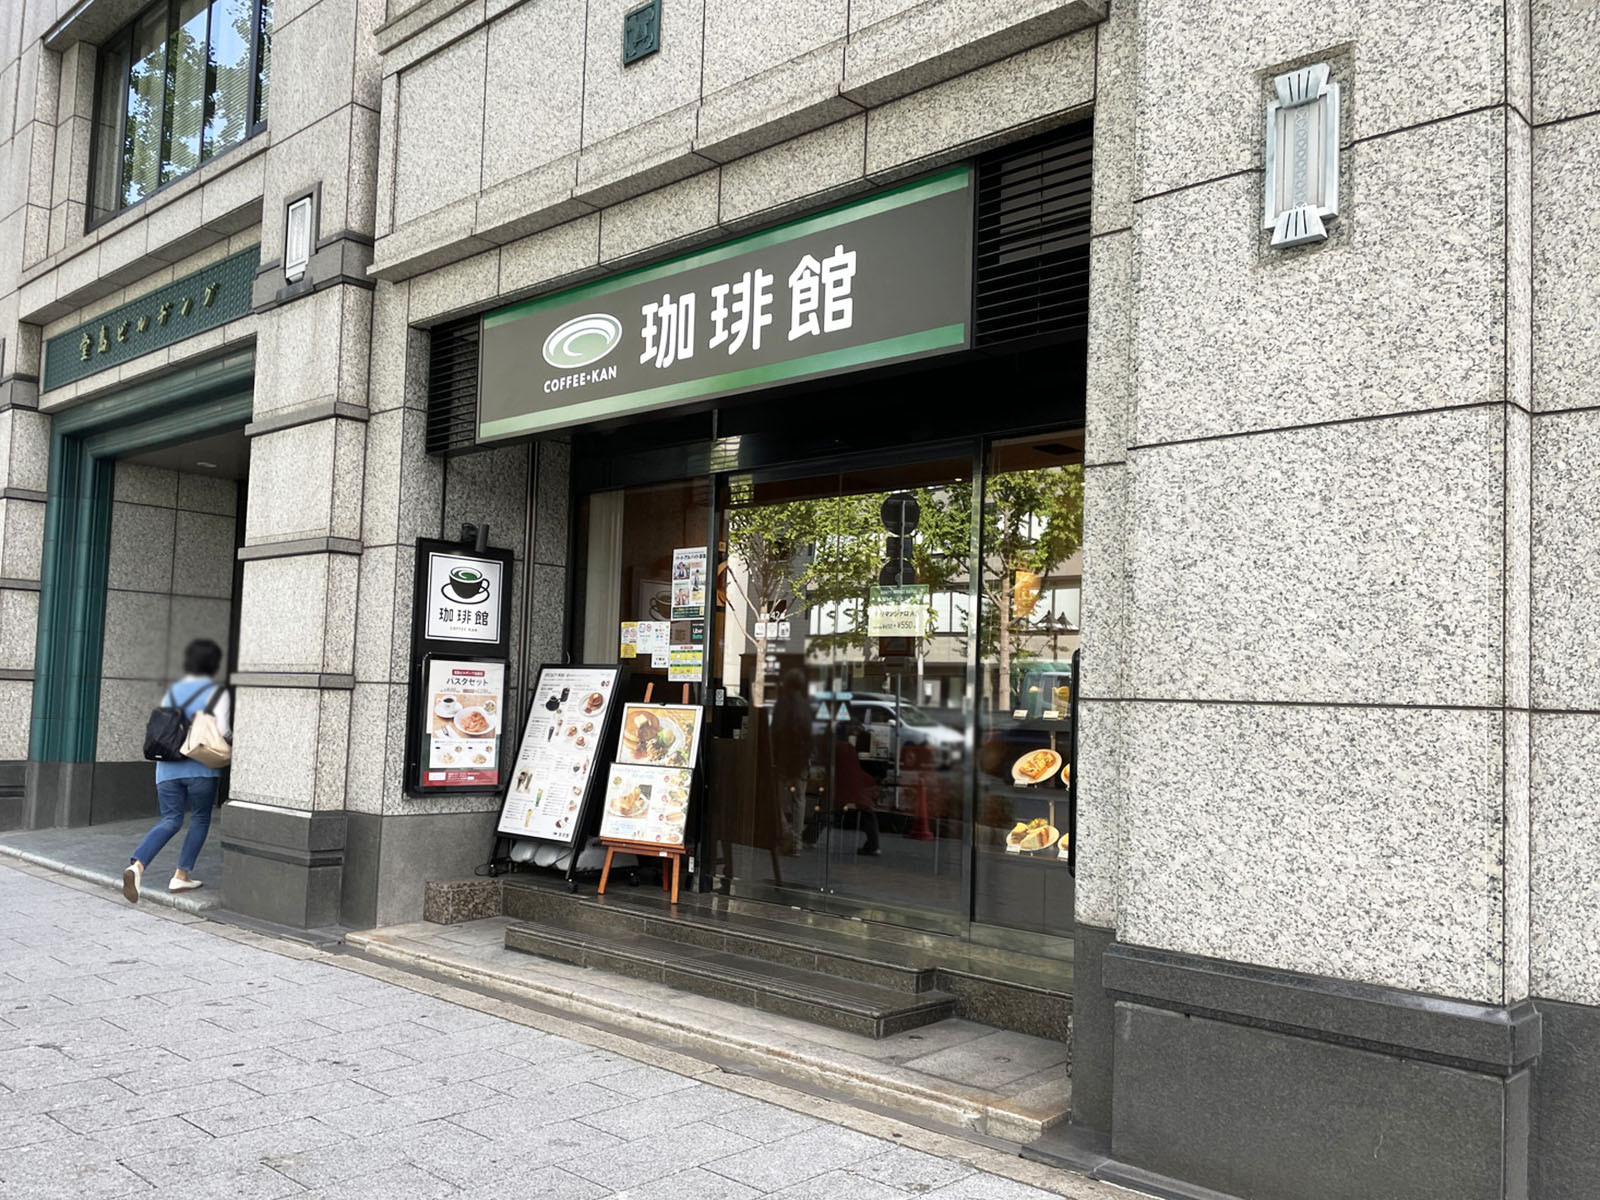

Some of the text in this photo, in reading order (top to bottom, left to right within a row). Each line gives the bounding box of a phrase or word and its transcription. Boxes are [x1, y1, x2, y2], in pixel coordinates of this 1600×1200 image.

[638, 244, 857, 369] 珈琲館
[438, 607, 489, 626] 珈琲館
[446, 677, 489, 687] パスタセット
